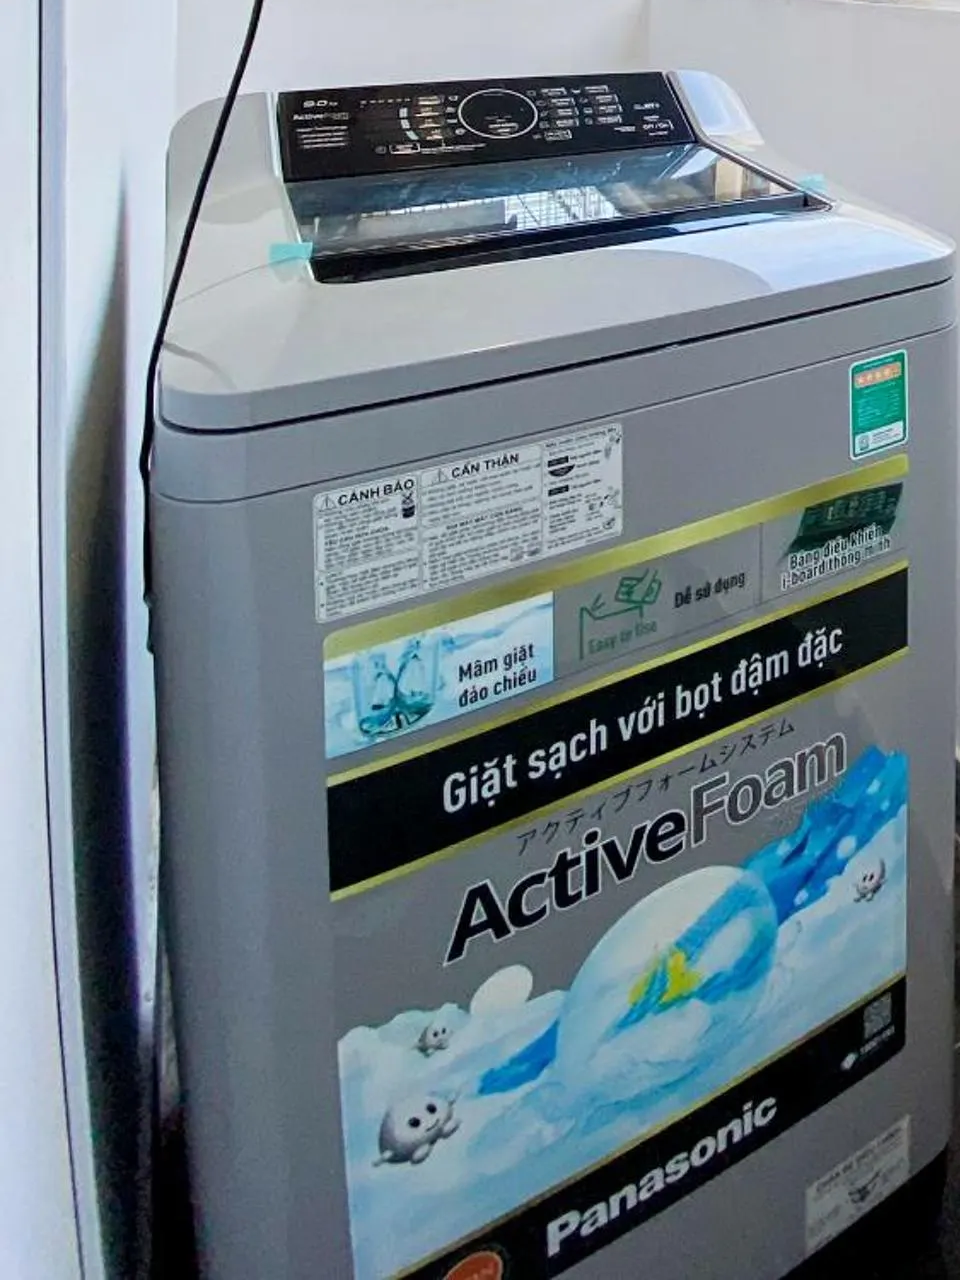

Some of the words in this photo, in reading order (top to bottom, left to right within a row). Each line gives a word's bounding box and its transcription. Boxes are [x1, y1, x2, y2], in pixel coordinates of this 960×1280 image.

[714, 572, 745, 594] dụng
[458, 658, 498, 683] Mâm
[503, 643, 535, 671] giặt
[458, 685, 489, 708] đảo
[493, 665, 537, 696] chiều
[442, 753, 518, 814] Giặt
[527, 717, 608, 780] sạch
[617, 690, 665, 742] với
[675, 671, 723, 720] bọt
[730, 652, 790, 697] đậm
[797, 626, 843, 669] đặc
[442, 732, 848, 967] ActiveFoam
[546, 1096, 778, 1258] Panasonic
